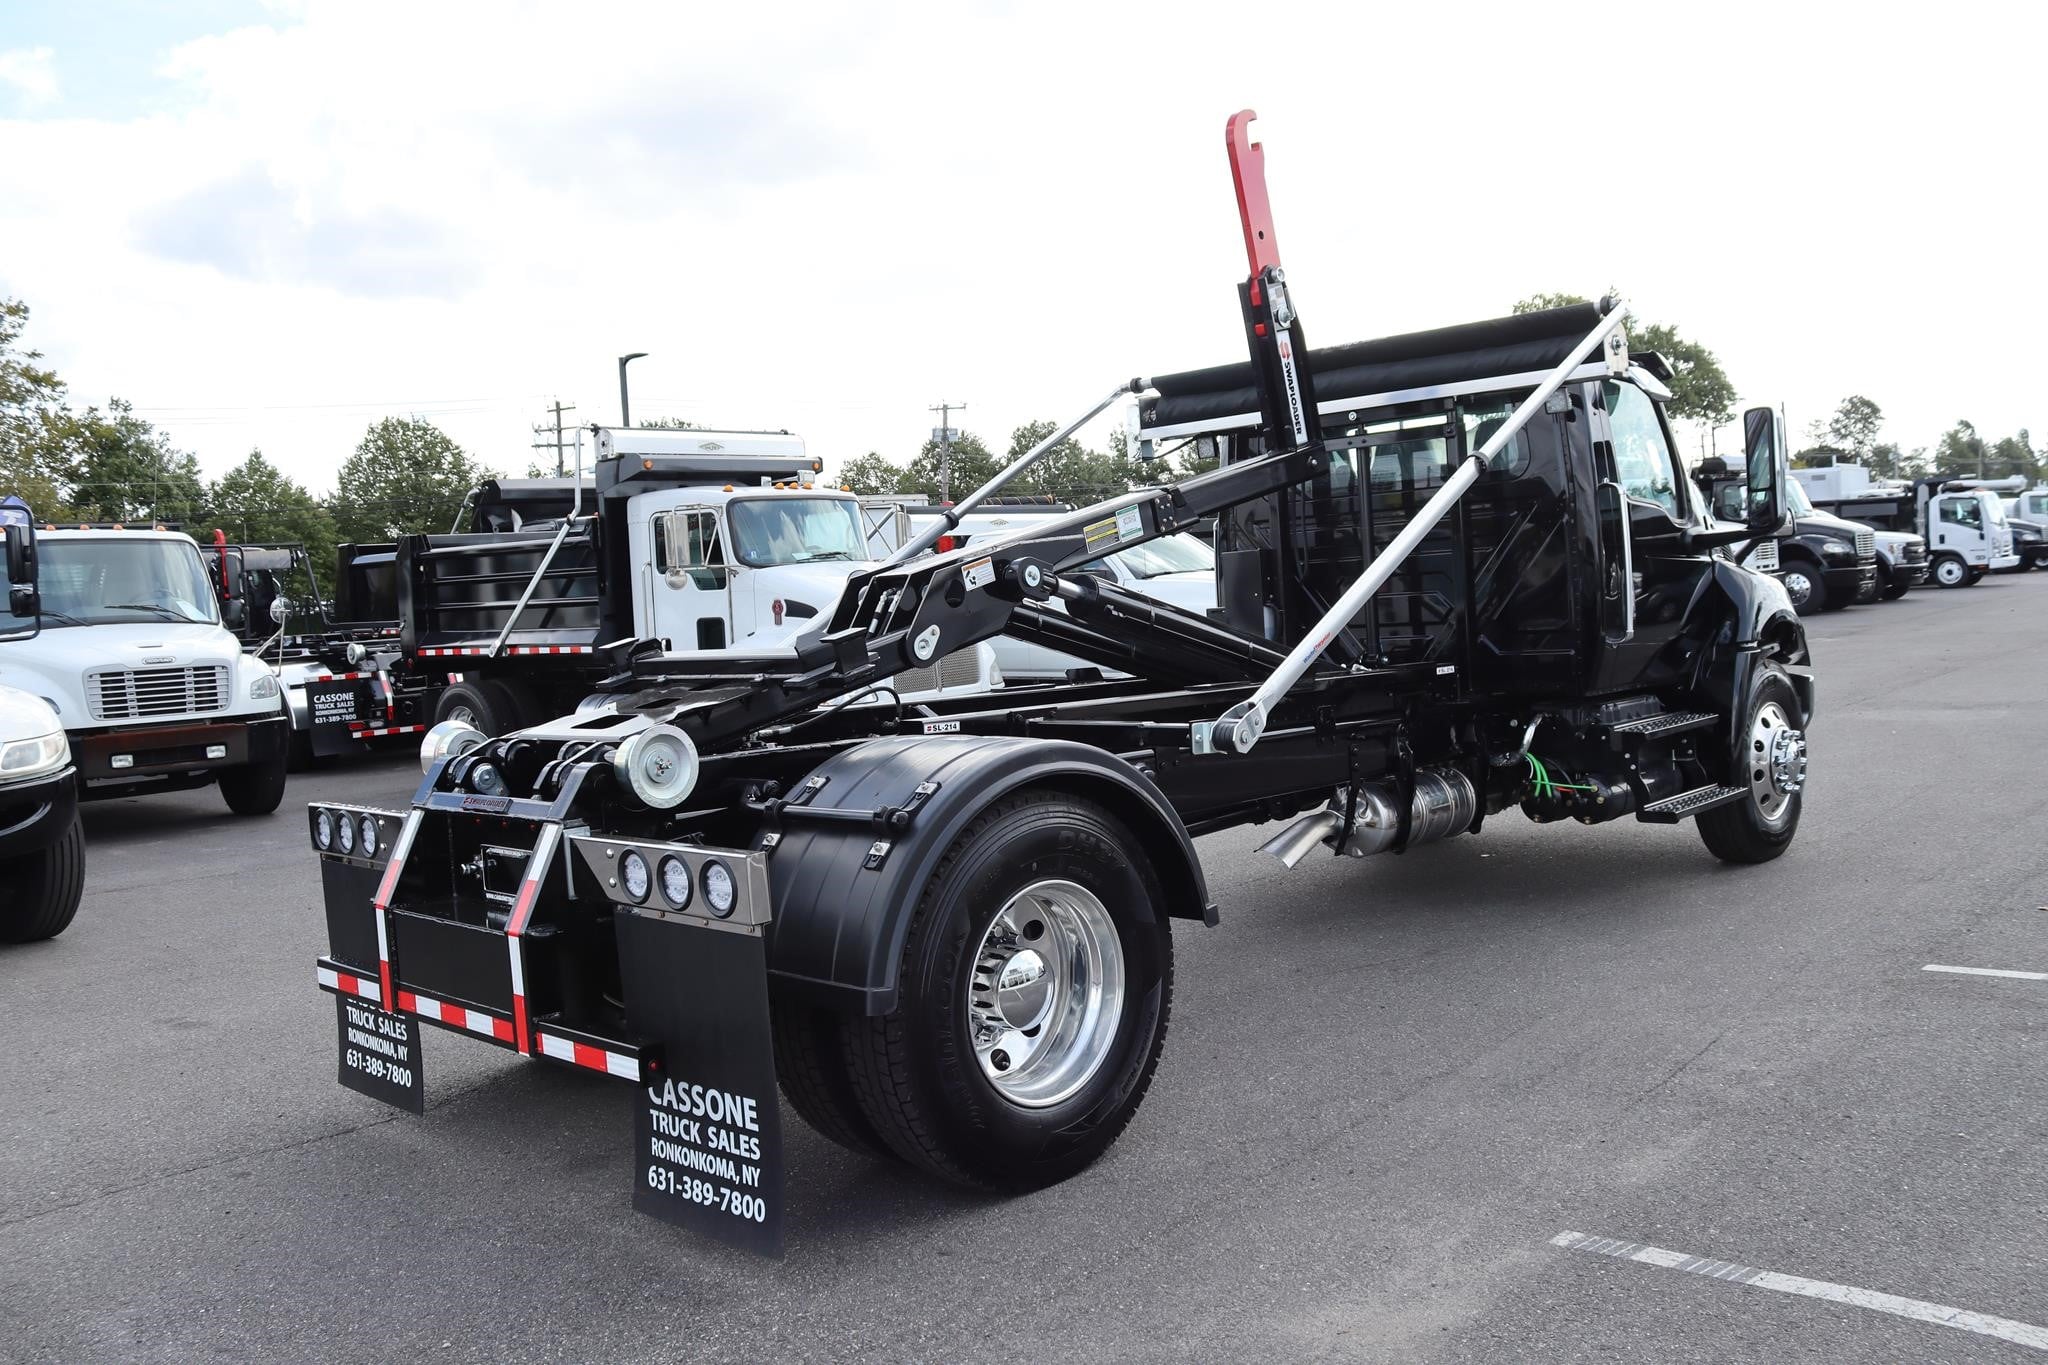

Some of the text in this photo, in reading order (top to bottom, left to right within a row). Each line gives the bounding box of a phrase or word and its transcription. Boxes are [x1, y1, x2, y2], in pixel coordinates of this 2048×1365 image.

[1284, 361, 1302, 435] SWAPLOADER
[313, 692, 354, 703] CASSONE
[314, 714, 357, 724] 631-389-7800
[346, 1005, 376, 1031] TRUCK
[378, 1016, 408, 1041] SALES
[348, 1027, 408, 1062] RONKONKOMA, NY
[346, 1048, 412, 1088] 631-389-7800
[650, 1108, 761, 1161] TRUCK SALES
[651, 1137, 761, 1188] RONKONKOMA, NY
[648, 1165, 766, 1223] 631-389-7800
